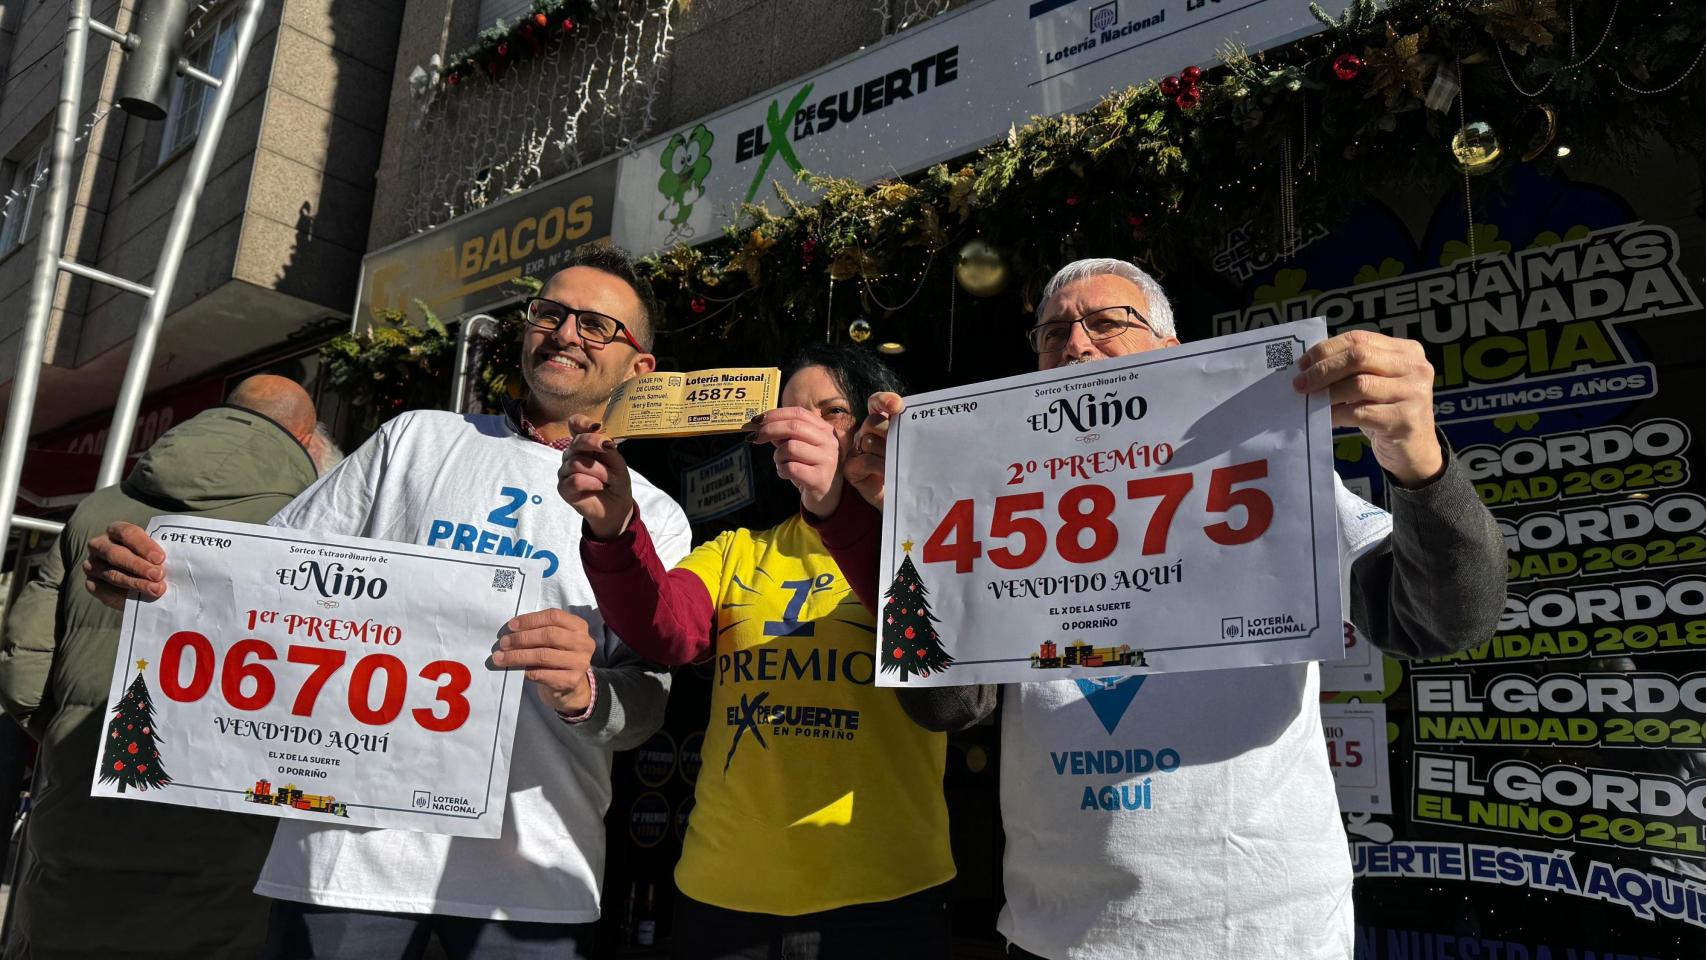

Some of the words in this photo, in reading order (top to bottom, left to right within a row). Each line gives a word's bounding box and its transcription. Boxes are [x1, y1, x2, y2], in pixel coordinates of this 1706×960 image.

[1100, 9, 1165, 44] Nacional
[817, 45, 960, 129] SUERTE
[795, 103, 816, 125] DE
[736, 128, 769, 163] EL
[795, 122, 815, 142] LA
[1527, 233, 1668, 287] MÁS
[721, 373, 764, 383] Nacional
[1034, 387, 1061, 398] Sorteo
[1063, 374, 1127, 392] Extraordinario
[1129, 372, 1139, 381] de
[1461, 386, 1563, 412] ÚLTIMOS
[1570, 374, 1647, 397] AÑOS
[686, 387, 746, 402] 45875
[911, 412, 918, 420] 6
[919, 408, 936, 418] DE
[937, 401, 978, 415] ENERO
[1047, 391, 1147, 433] Niño
[1043, 441, 1174, 482] PREMIO
[1459, 423, 1685, 480] GORDO
[1562, 459, 1684, 495] 2023
[922, 459, 1274, 574] 45875
[160, 533, 167, 541] 6
[169, 532, 187, 543] DE
[189, 535, 232, 548] ENERO
[289, 545, 316, 556] Sorteo
[318, 548, 376, 562] Extraordinario
[378, 555, 388, 564] de
[1583, 536, 1706, 571] 2022
[294, 560, 388, 600] Niño
[988, 572, 1106, 599] VENDIDO
[1111, 558, 1183, 592] AQUÍ
[1050, 608, 1060, 616] EL
[1062, 607, 1068, 615] X
[1069, 606, 1082, 614] DE
[1083, 605, 1094, 613] LA
[1096, 601, 1131, 612] SUERTE
[1062, 622, 1070, 631] O
[1071, 617, 1118, 630] PORRIÑO
[1247, 613, 1294, 627] LOTERÍA
[283, 614, 402, 646] PREMIO
[1248, 623, 1307, 637] NACIONAL
[159, 630, 471, 733] 06703
[719, 648, 876, 686] PREMIO
[1417, 679, 1483, 712] EL
[771, 704, 859, 730] SUERTE
[1418, 716, 1598, 741] NAVIDAD
[1603, 719, 1706, 744] 202
[214, 716, 323, 746] VENDIDO
[325, 731, 390, 755] AQUÍ
[773, 727, 789, 736] EN
[795, 728, 854, 741] PORRIÑO
[268, 751, 279, 759] EL
[280, 752, 286, 760] X
[286, 753, 296, 761] DE
[298, 755, 309, 763] LA
[310, 756, 340, 766] SUERTE
[278, 766, 285, 774] O
[286, 767, 327, 779] PORRIÑO
[1050, 748, 1181, 775] VENDIDO
[1418, 756, 1485, 797] EL
[432, 803, 477, 814] NACIONAL
[433, 795, 469, 806] LOTERÍA
[1080, 777, 1152, 811] AQUÍ
[1418, 794, 1462, 822] EL
[1469, 801, 1574, 835] NIÑO
[1580, 814, 1706, 852] 2021
[1472, 848, 1574, 889] ESTÁ
